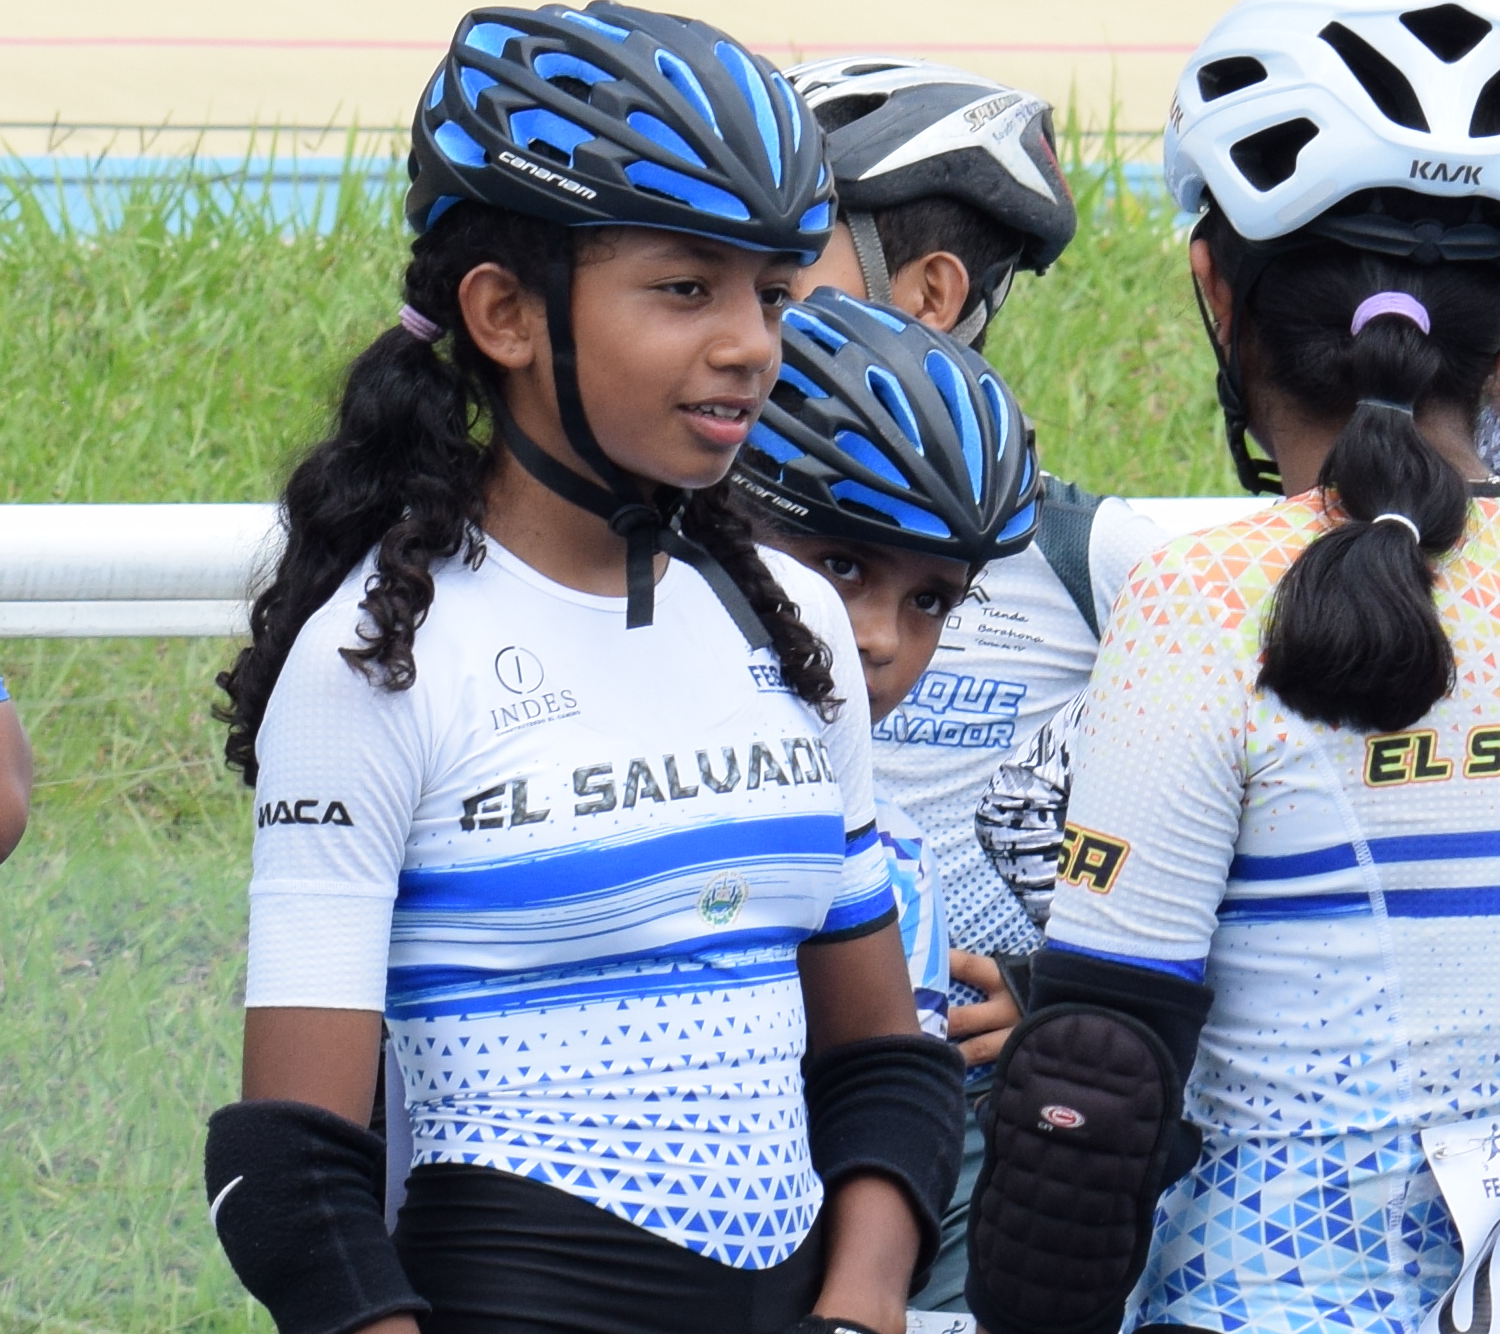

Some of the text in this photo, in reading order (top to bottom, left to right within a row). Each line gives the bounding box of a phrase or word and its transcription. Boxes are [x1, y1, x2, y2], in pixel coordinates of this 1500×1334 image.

[498, 151, 597, 200] canariam
[1409, 159, 1483, 186] KASK
[977, 624, 1045, 643] Barahona
[981, 607, 1030, 623] Tienda
[490, 689, 579, 731] INDES
[1362, 728, 1453, 788] EL
[459, 778, 551, 832] EL
